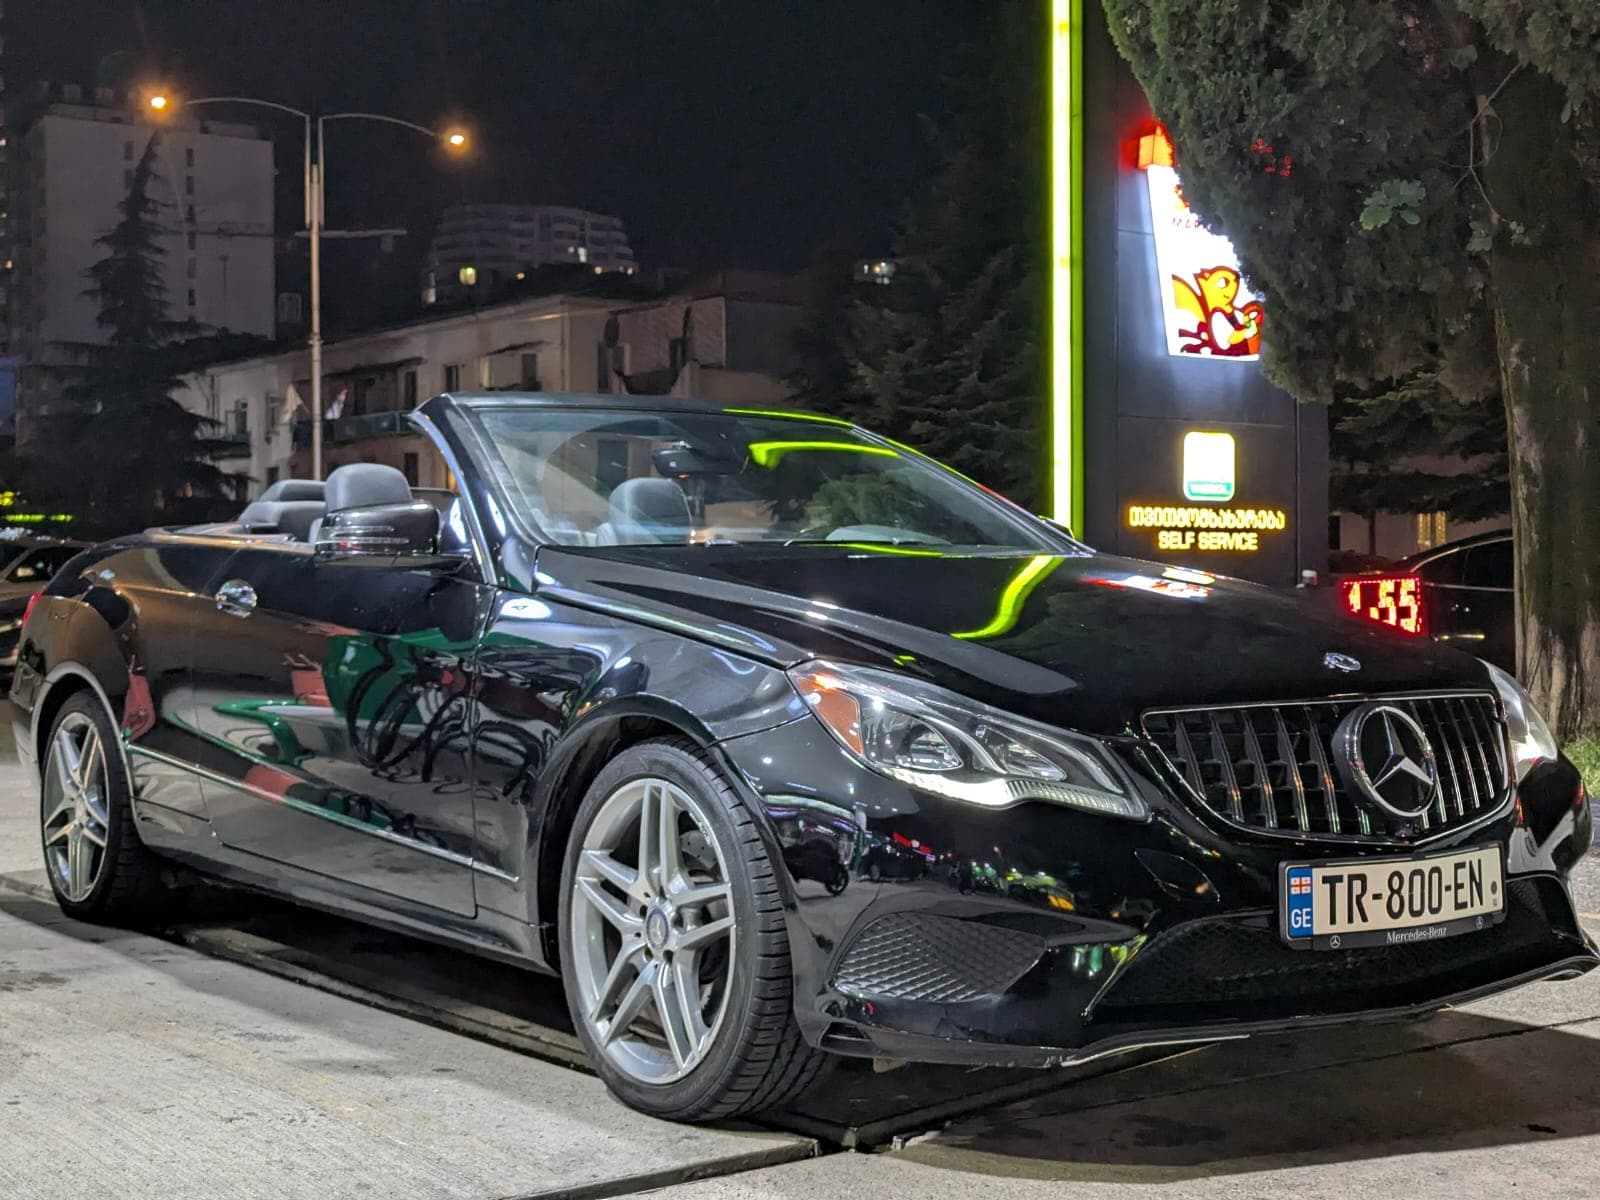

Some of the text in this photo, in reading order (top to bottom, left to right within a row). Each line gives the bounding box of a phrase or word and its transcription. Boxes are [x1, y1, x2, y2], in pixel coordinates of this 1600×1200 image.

[1158, 531, 1258, 550] SELF SERVICE
[1291, 858, 1484, 929] GE TR-800-EN
[1386, 926, 1448, 944] Mercedes-Benz
